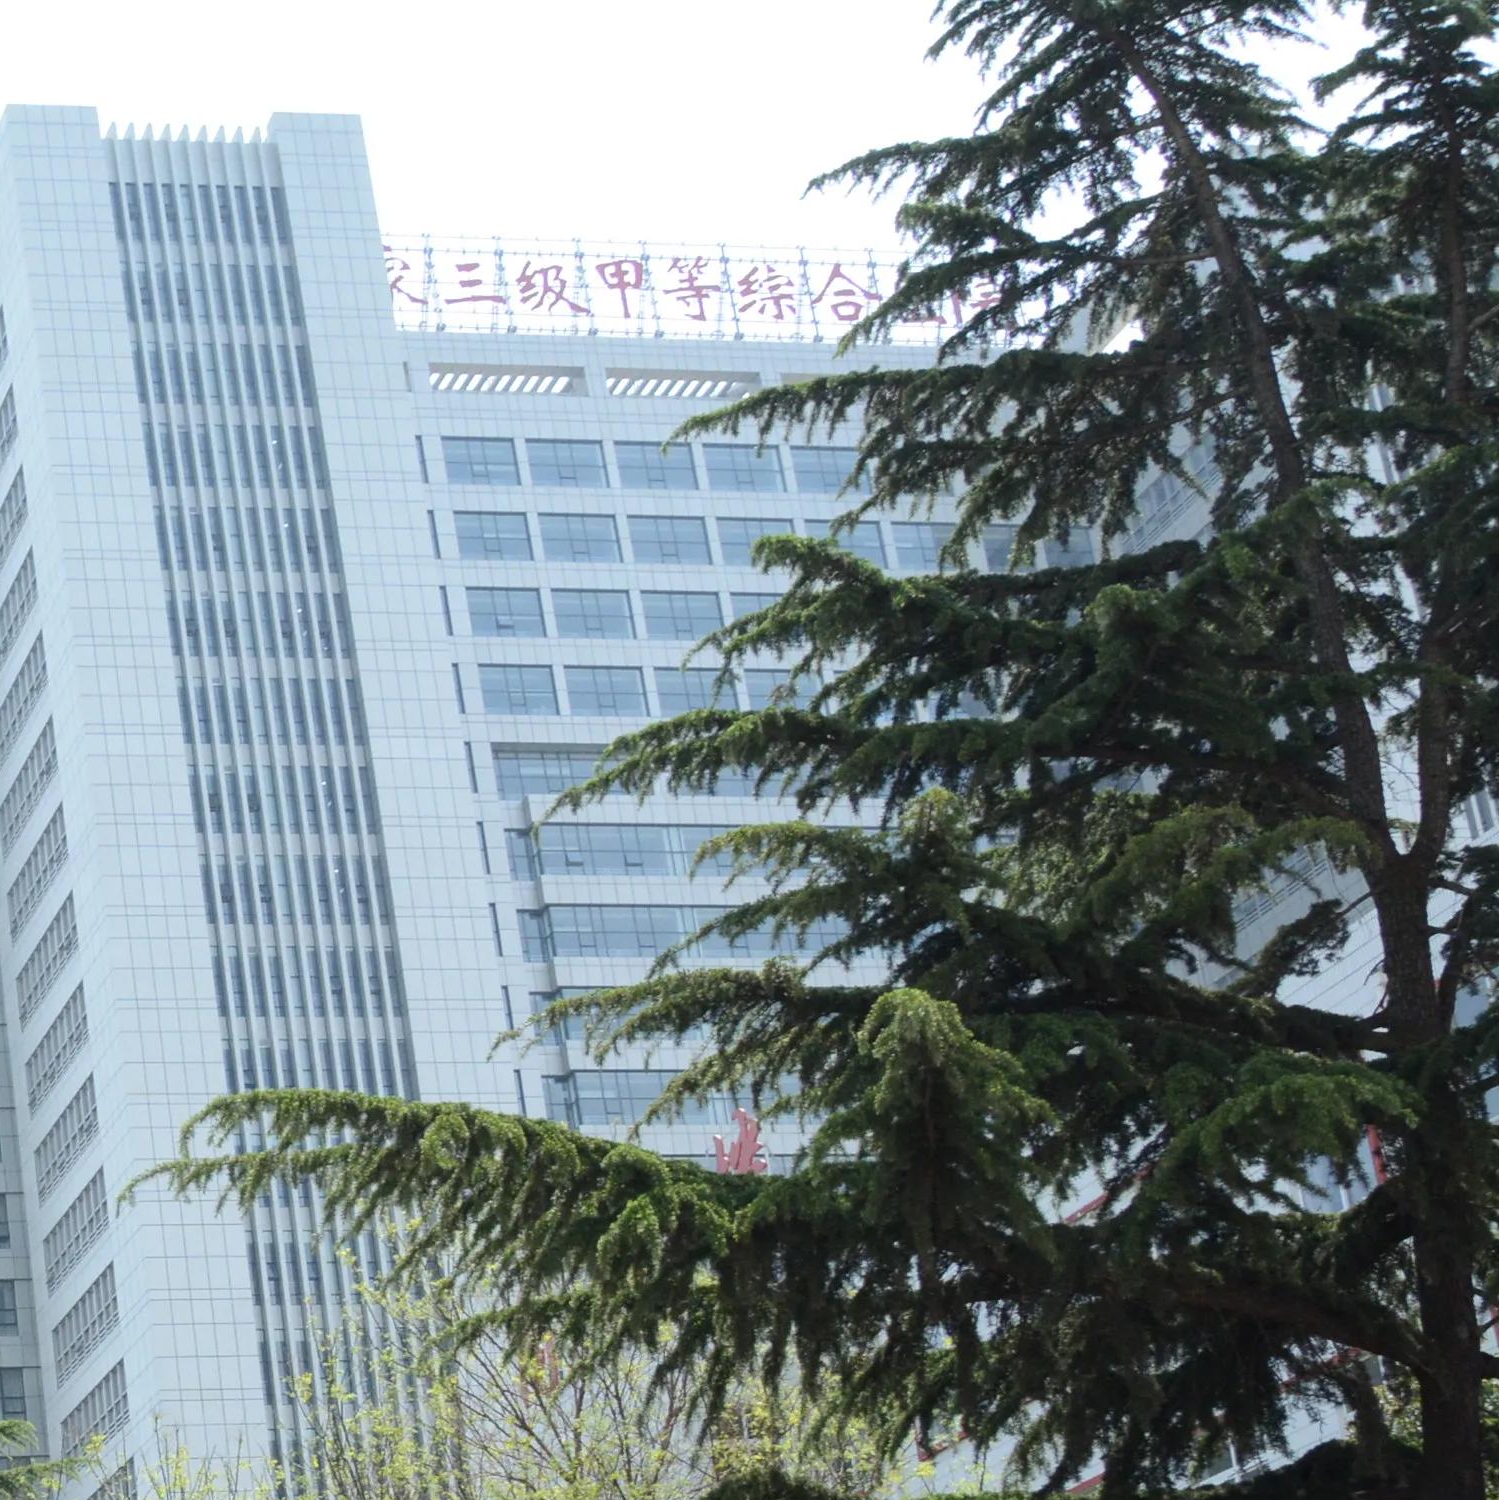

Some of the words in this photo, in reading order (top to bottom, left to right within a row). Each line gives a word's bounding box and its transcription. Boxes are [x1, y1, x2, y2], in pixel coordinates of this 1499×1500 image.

[382, 244, 1005, 325] 三级甲等综合
